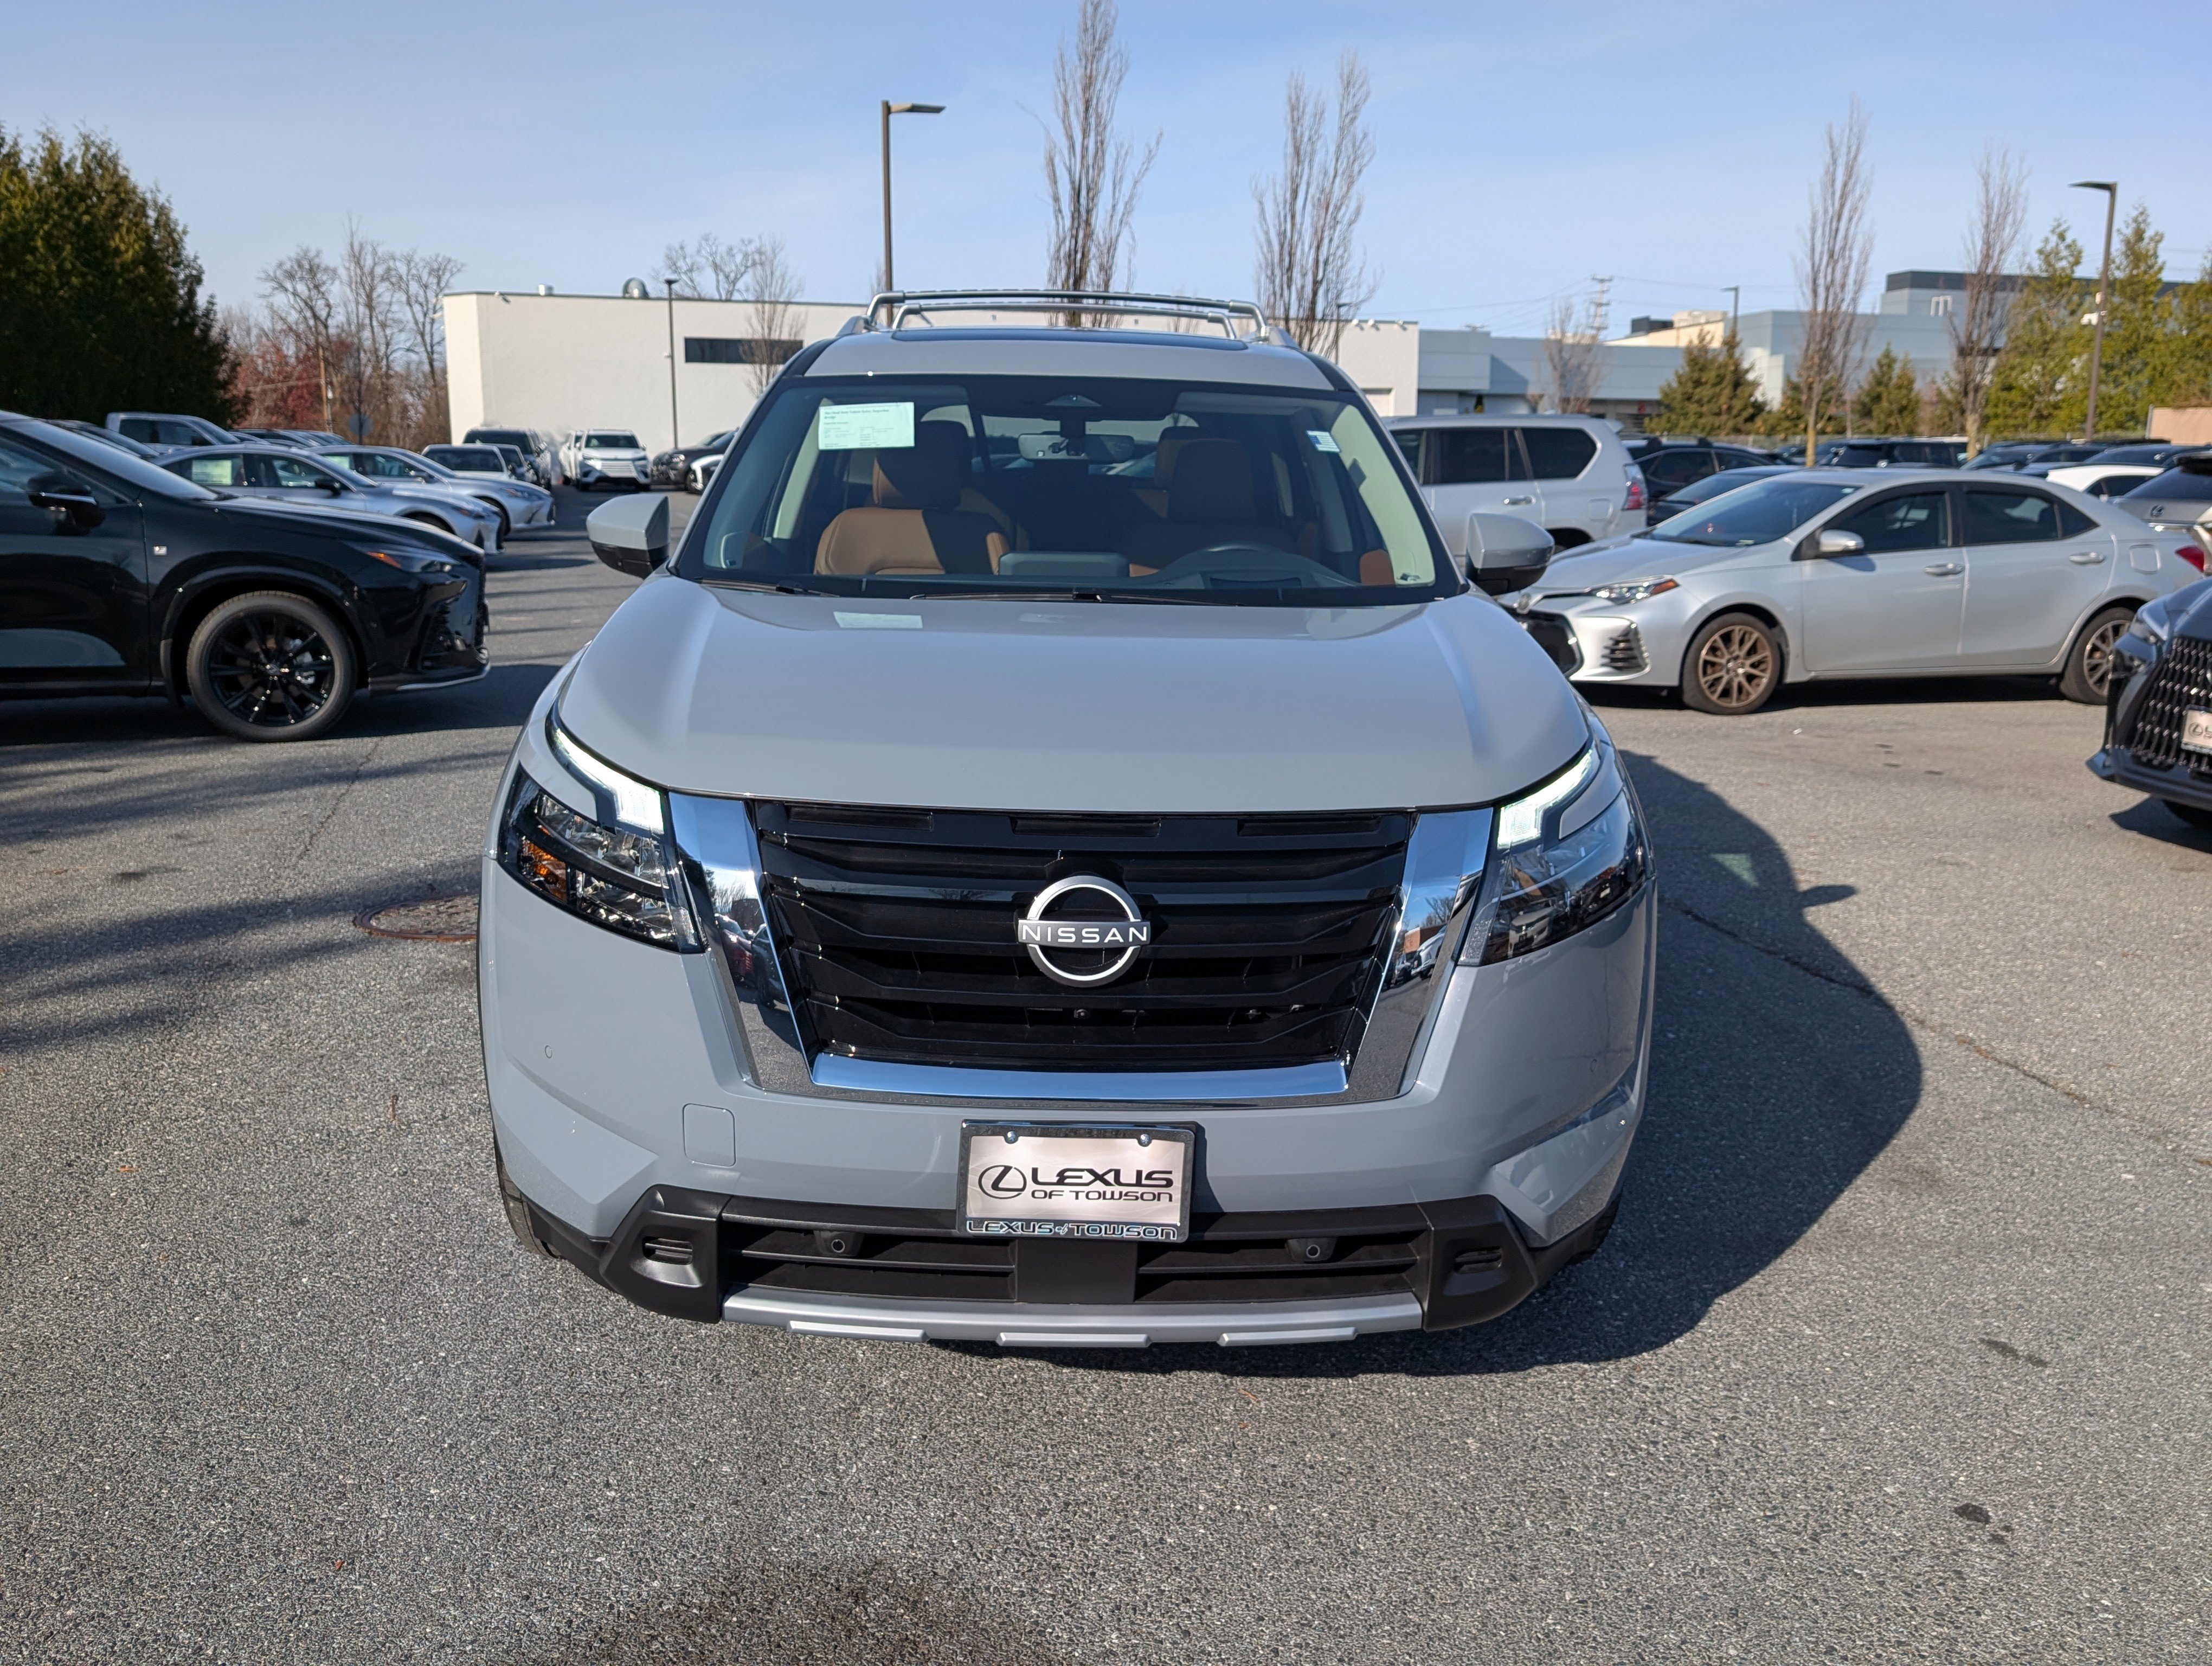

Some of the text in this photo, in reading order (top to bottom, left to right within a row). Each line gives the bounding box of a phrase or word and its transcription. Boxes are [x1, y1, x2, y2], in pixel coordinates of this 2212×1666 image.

[1022, 924, 1147, 943] NISSAN
[1031, 1167, 1174, 1188] LEXUS
[1031, 1189, 1173, 1202] OF TOWSON
[966, 1220, 1178, 1240] LEXUS of TOWSON
